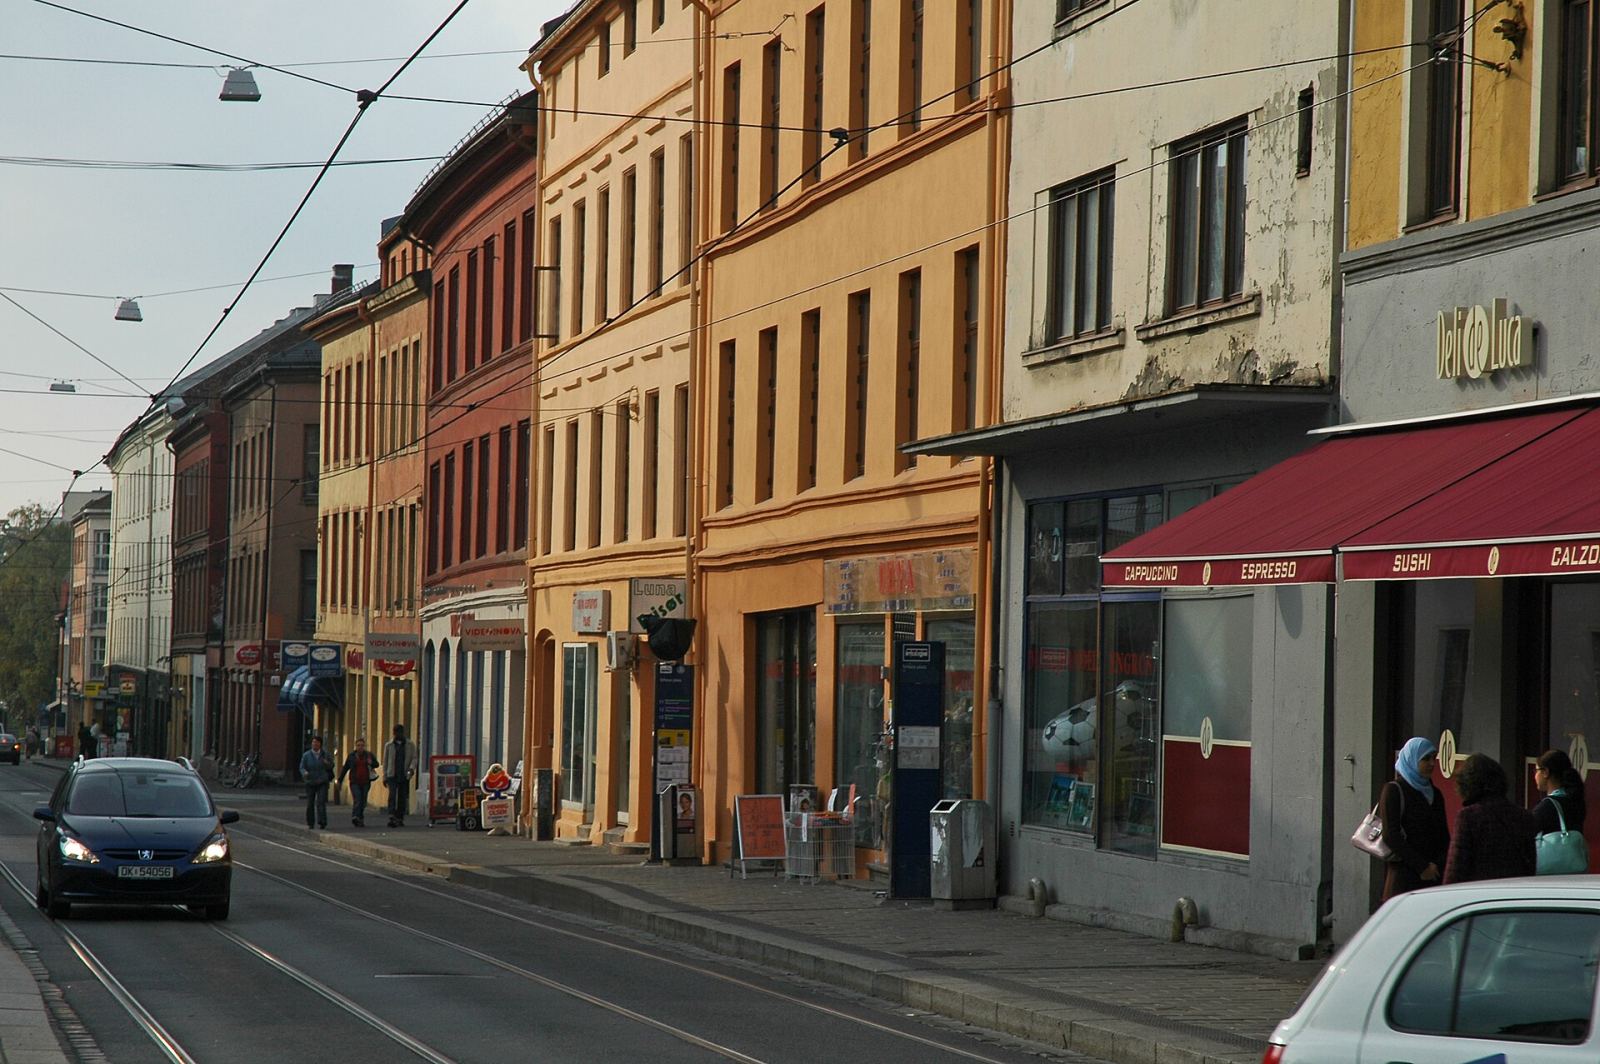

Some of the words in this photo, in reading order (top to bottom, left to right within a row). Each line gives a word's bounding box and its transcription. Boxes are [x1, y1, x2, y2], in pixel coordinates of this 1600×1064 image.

[1437, 306, 1461, 379] Deli
[1491, 298, 1521, 370] Luca
[1393, 553, 1431, 572] SUSHI
[1551, 544, 1600, 566] CALZO
[1125, 566, 1178, 581] CAPPUCCINO
[1241, 561, 1296, 579] ESPRESSO
[633, 580, 677, 596] Luna
[121, 866, 134, 877] DK
